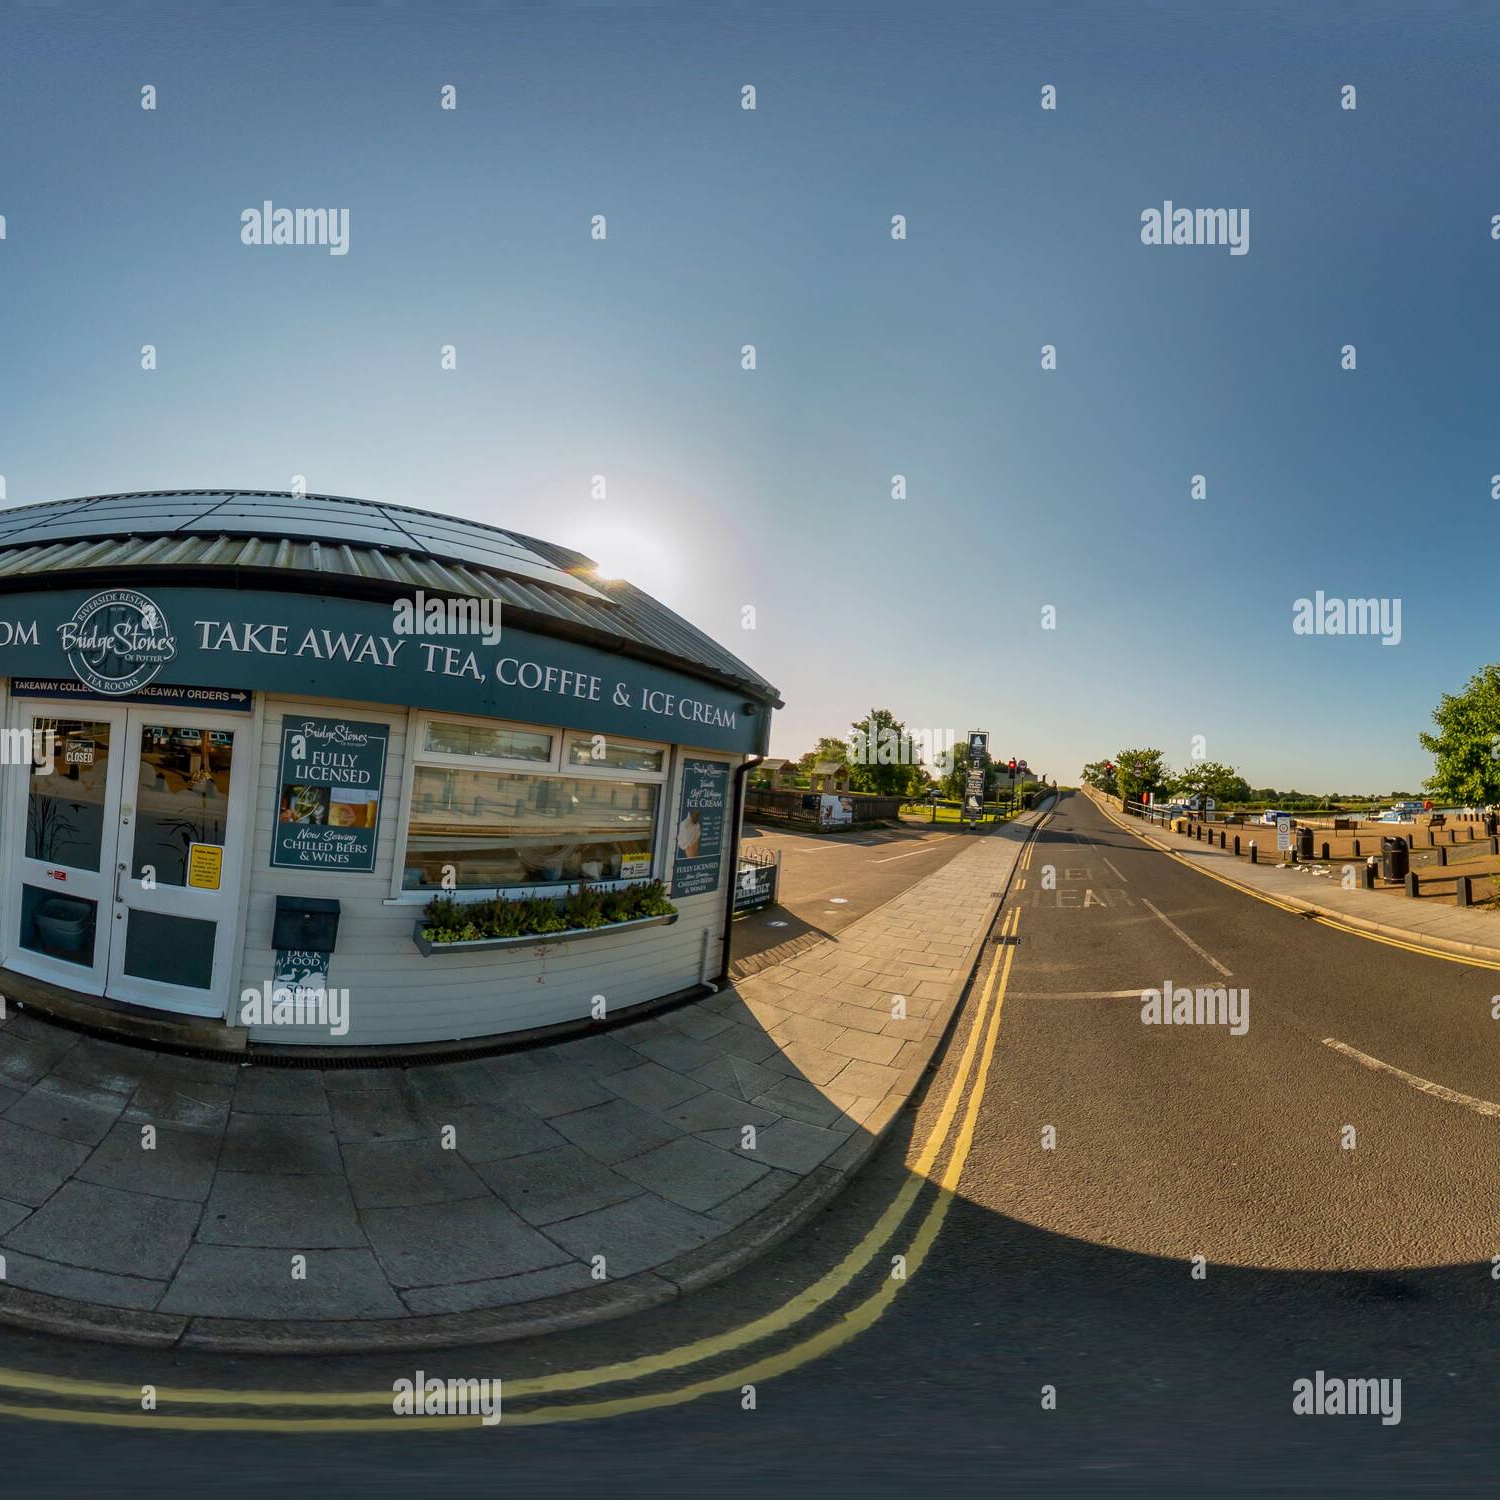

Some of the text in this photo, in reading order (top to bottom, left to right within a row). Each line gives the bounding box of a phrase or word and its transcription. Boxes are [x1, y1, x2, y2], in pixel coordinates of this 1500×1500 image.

[77, 592, 118, 621] RIVERSIDE
[56, 617, 175, 664] BridgeStones
[135, 654, 163, 662] POTTER
[85, 673, 140, 691] TEA ROOMS
[193, 620, 737, 730] TAKE AWAY TEA, COFFEE & ICE CREAM
[14, 681, 59, 691] TAKEAWAY
[187, 689, 230, 701] ORDERS
[301, 721, 368, 747] BridgeStones
[66, 751, 93, 763] CLOSED
[312, 751, 359, 768] FULLY
[295, 764, 371, 784] LICENSED
[686, 798, 723, 808] ICE CREAM
[296, 828, 357, 845] Now Serving
[283, 838, 368, 854] CHILLED BEERS
[299, 850, 349, 863] & WINES
[286, 956, 320, 967] FOOD
[287, 950, 322, 959] DUCK
